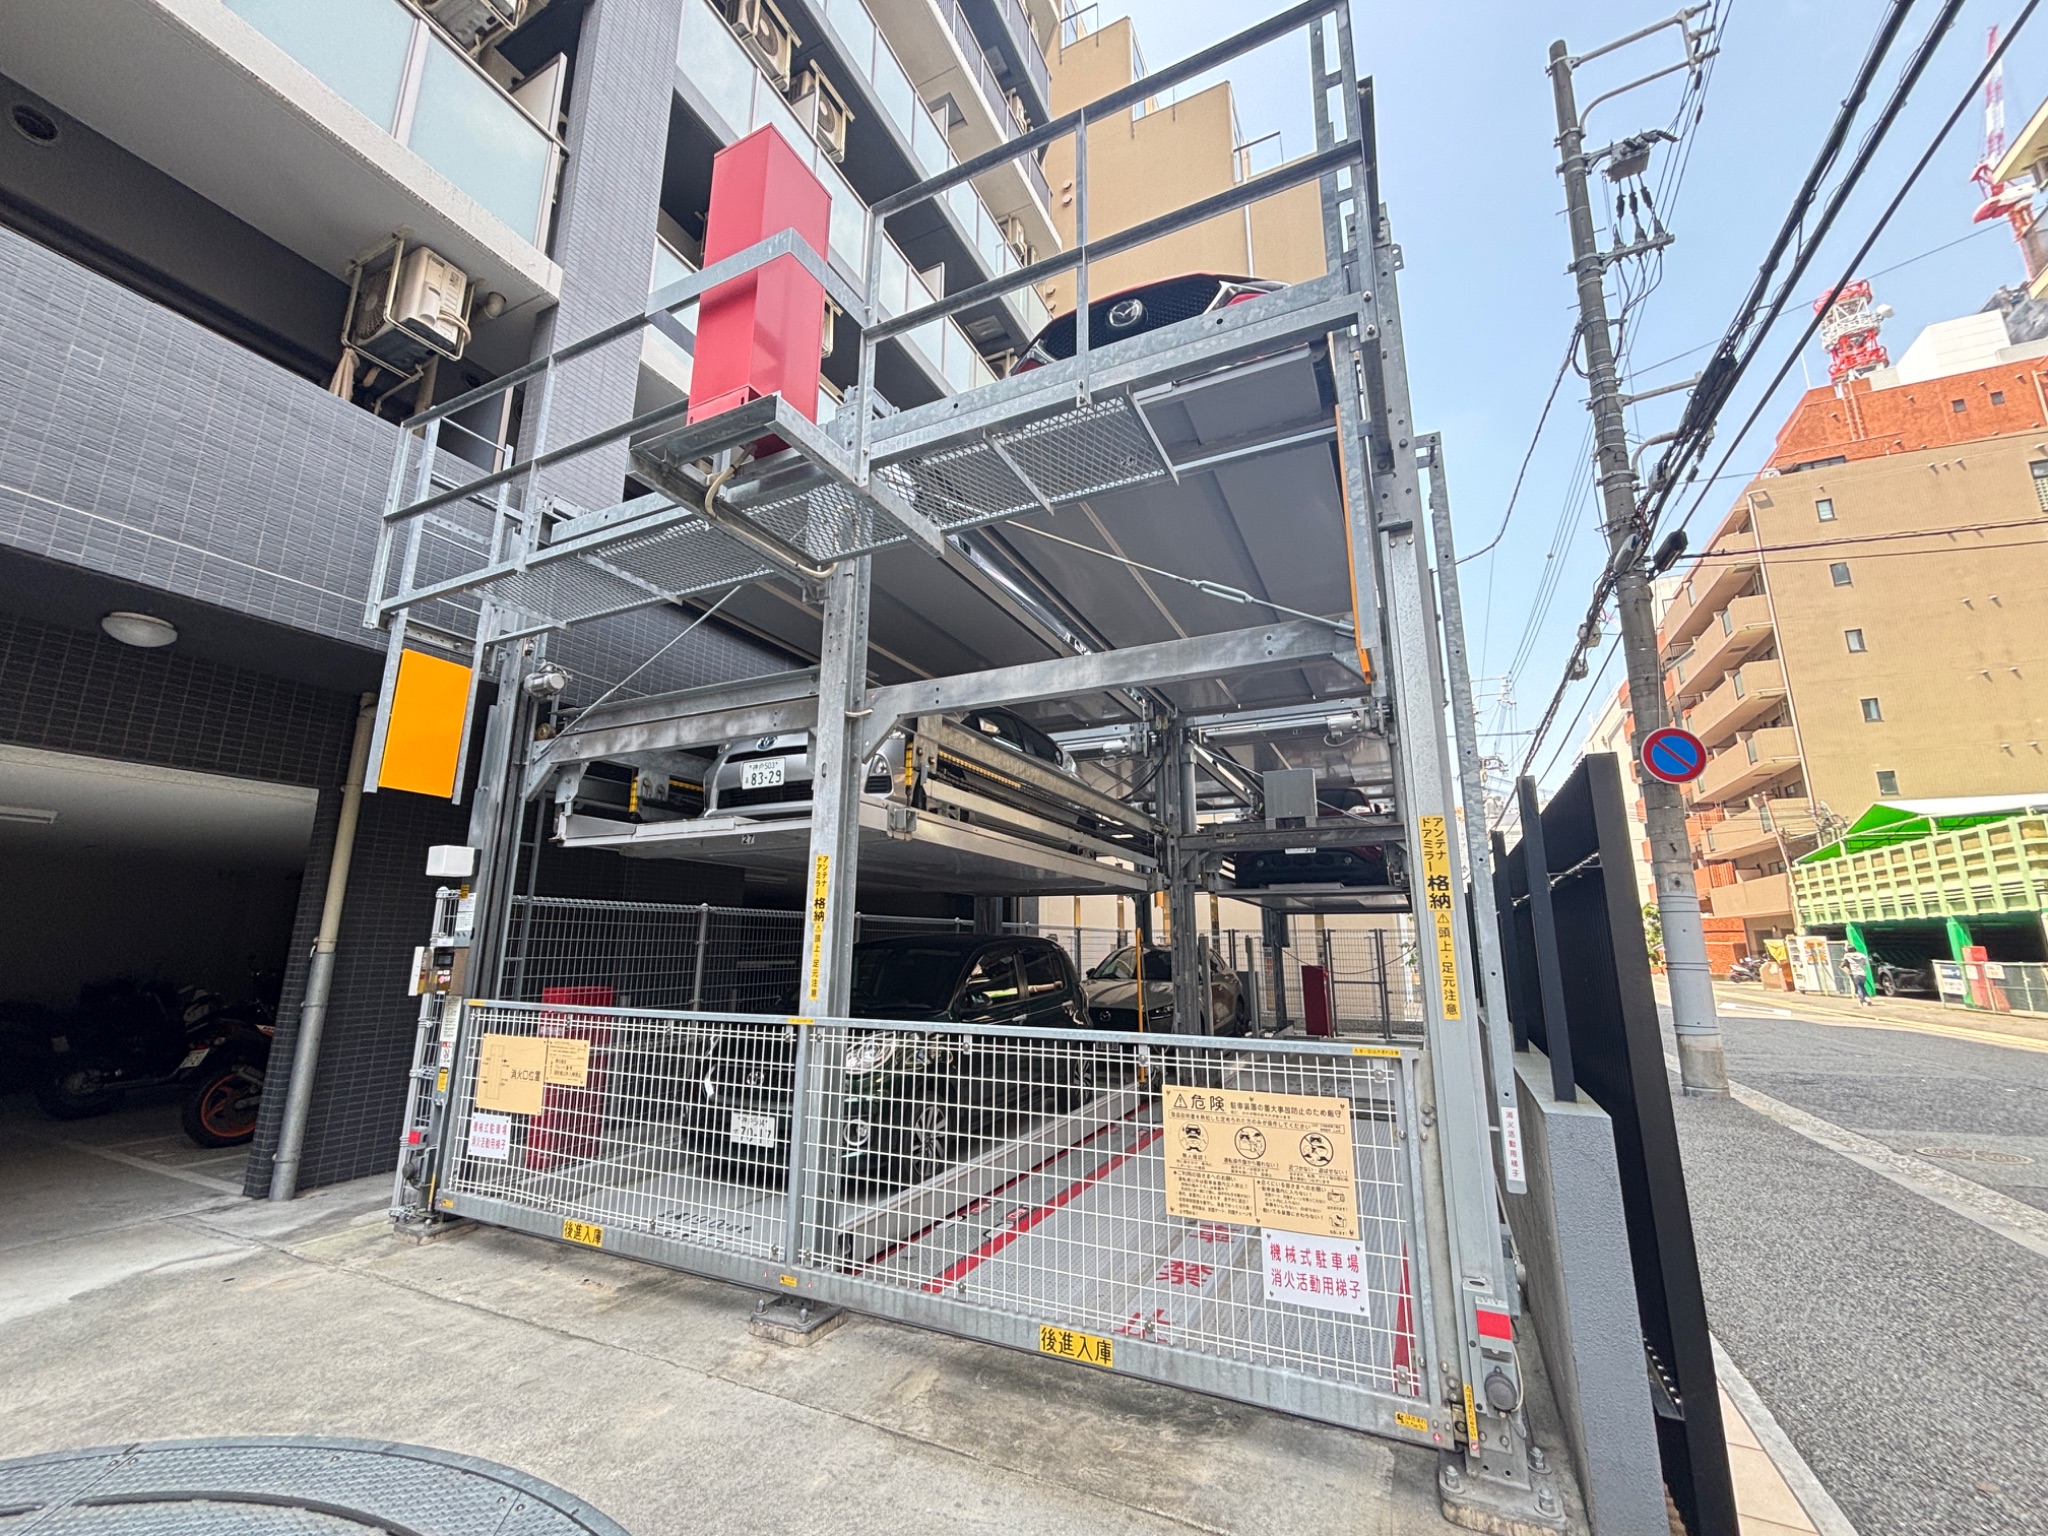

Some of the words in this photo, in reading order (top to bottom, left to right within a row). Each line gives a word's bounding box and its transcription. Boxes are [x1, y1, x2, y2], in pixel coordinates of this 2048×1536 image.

[743, 834, 754, 844] 27
[1422, 817, 1436, 872] ドアミラー
[1433, 817, 1448, 860] アンテナ
[1428, 875, 1451, 909] 格納
[814, 897, 826, 921] 格納
[1438, 927, 1459, 1016] 頭上・足元注意
[1191, 1094, 1225, 1112] 危険
[1506, 1111, 1519, 1177] 消火活動用梯子
[565, 1221, 602, 1244] 後進入庫
[1270, 1242, 1359, 1274] 機械式駐車場
[1271, 1268, 1361, 1299] 消火活動用梯子
[1041, 1327, 1112, 1364] 後進入庫
